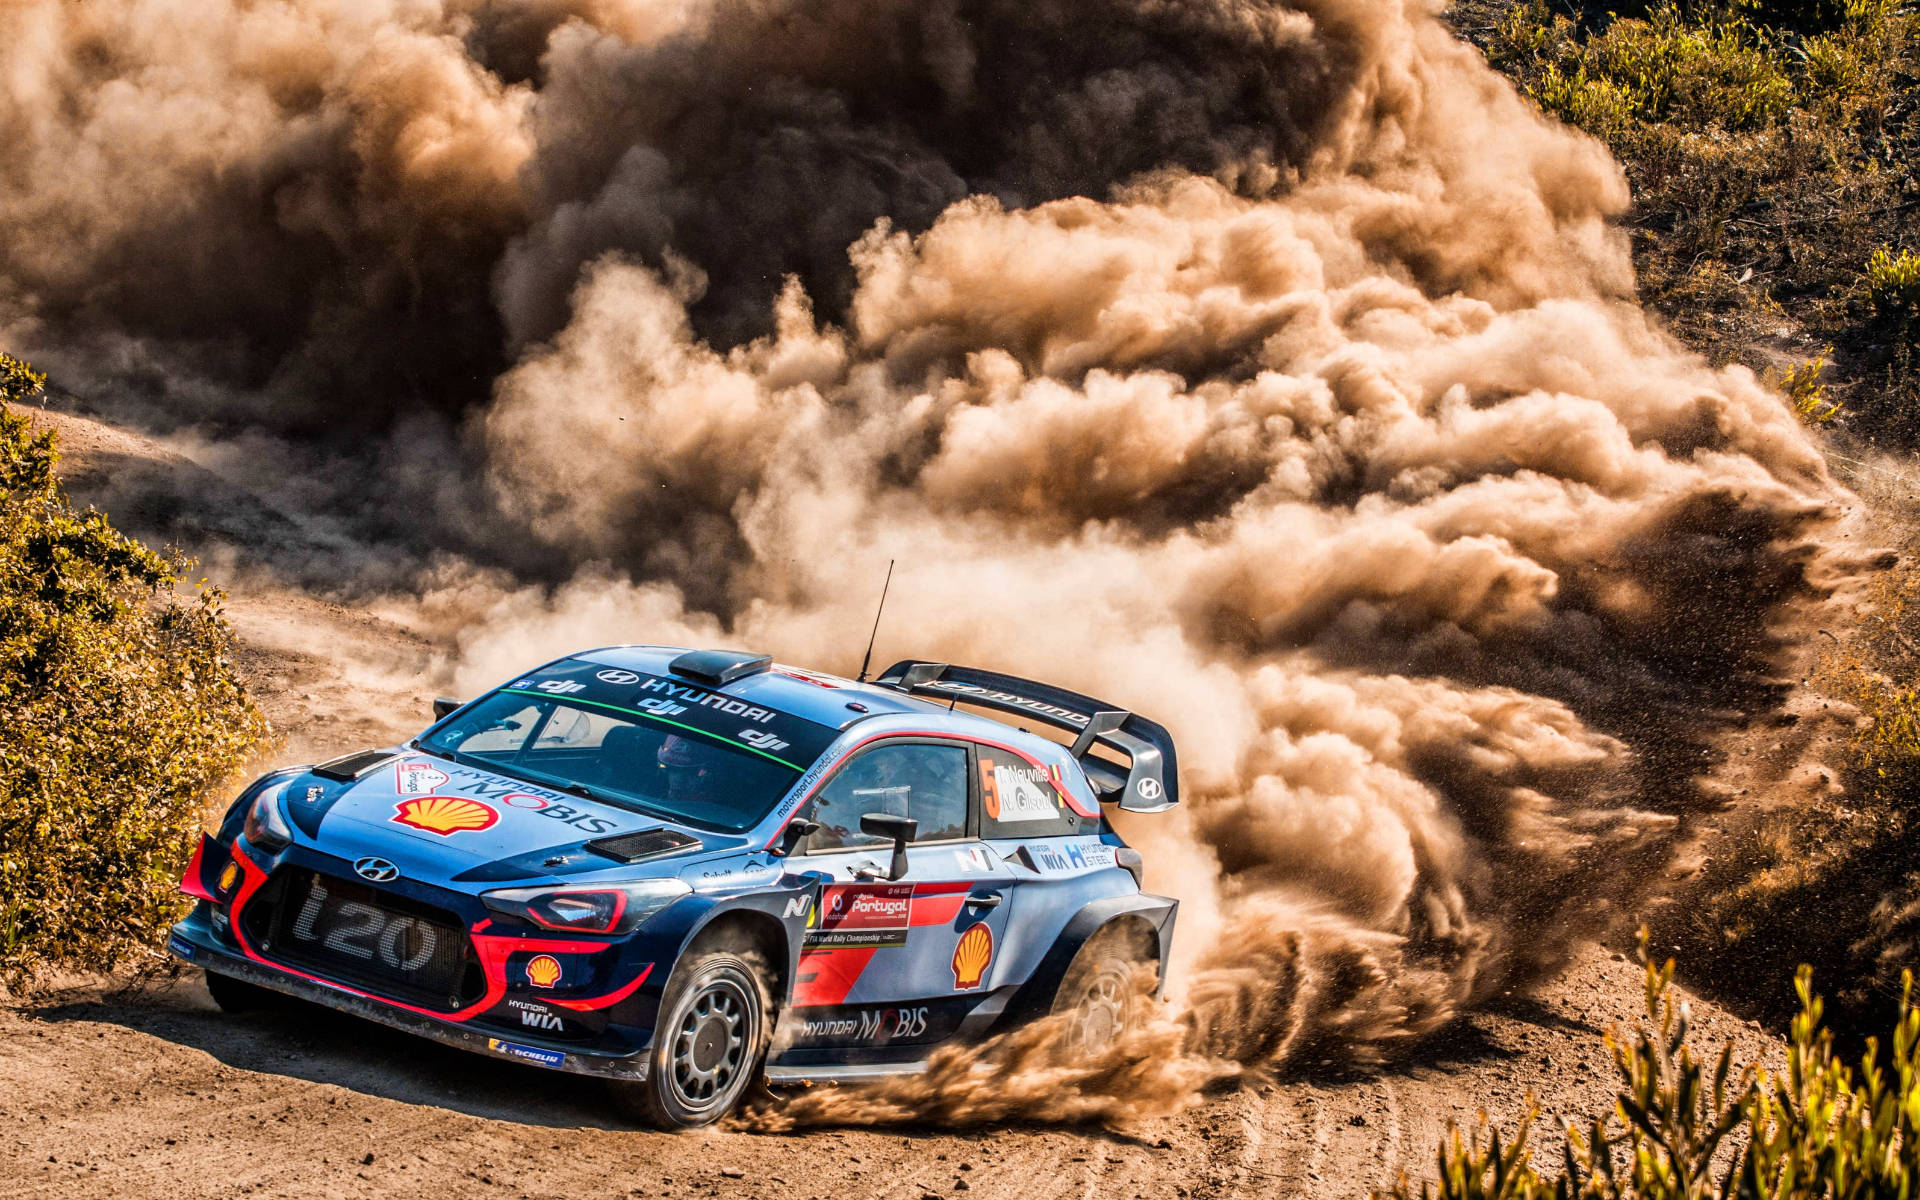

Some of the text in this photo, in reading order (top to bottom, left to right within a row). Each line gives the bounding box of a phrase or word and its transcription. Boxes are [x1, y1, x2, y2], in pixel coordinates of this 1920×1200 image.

[640, 678, 776, 723] HYUNDAI
[1007, 764, 1049, 783] Neuville
[449, 769, 568, 802] HYUNDAI
[980, 759, 1001, 819] 5
[458, 781, 618, 834] MOBIS
[1086, 856, 1112, 866] STEEL
[852, 899, 907, 914] Portugal
[833, 935, 846, 944] Rally
[846, 934, 881, 943] Championship
[508, 1000, 548, 1013] HYUNDAI
[800, 1017, 858, 1038] HYUNDAI
[855, 1006, 929, 1041] MOBIS
